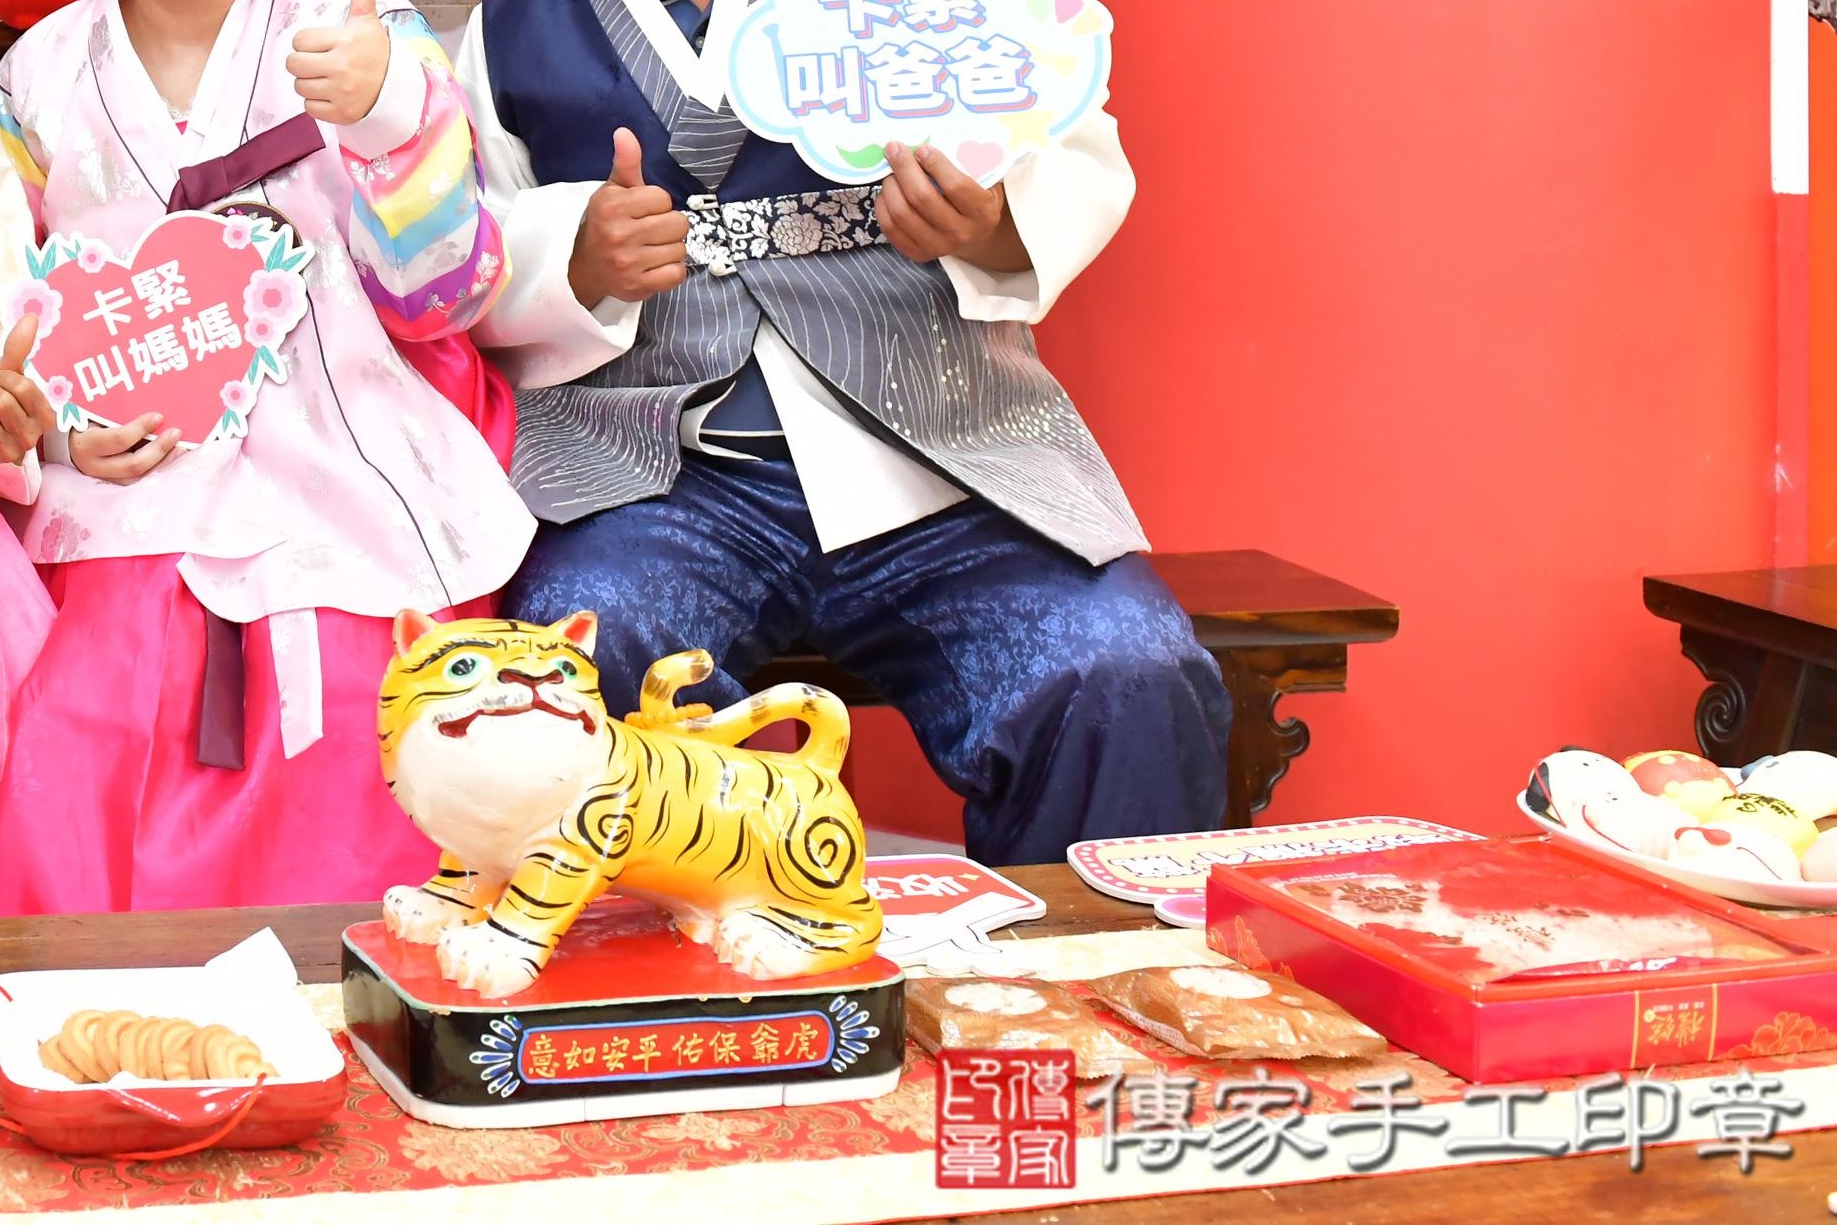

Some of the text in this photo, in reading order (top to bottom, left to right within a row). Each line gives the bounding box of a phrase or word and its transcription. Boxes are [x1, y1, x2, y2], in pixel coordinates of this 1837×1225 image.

[784, 33, 1038, 123] 叫爸爸
[82, 259, 192, 337] 卡緊
[73, 301, 243, 402] 叫媽媽
